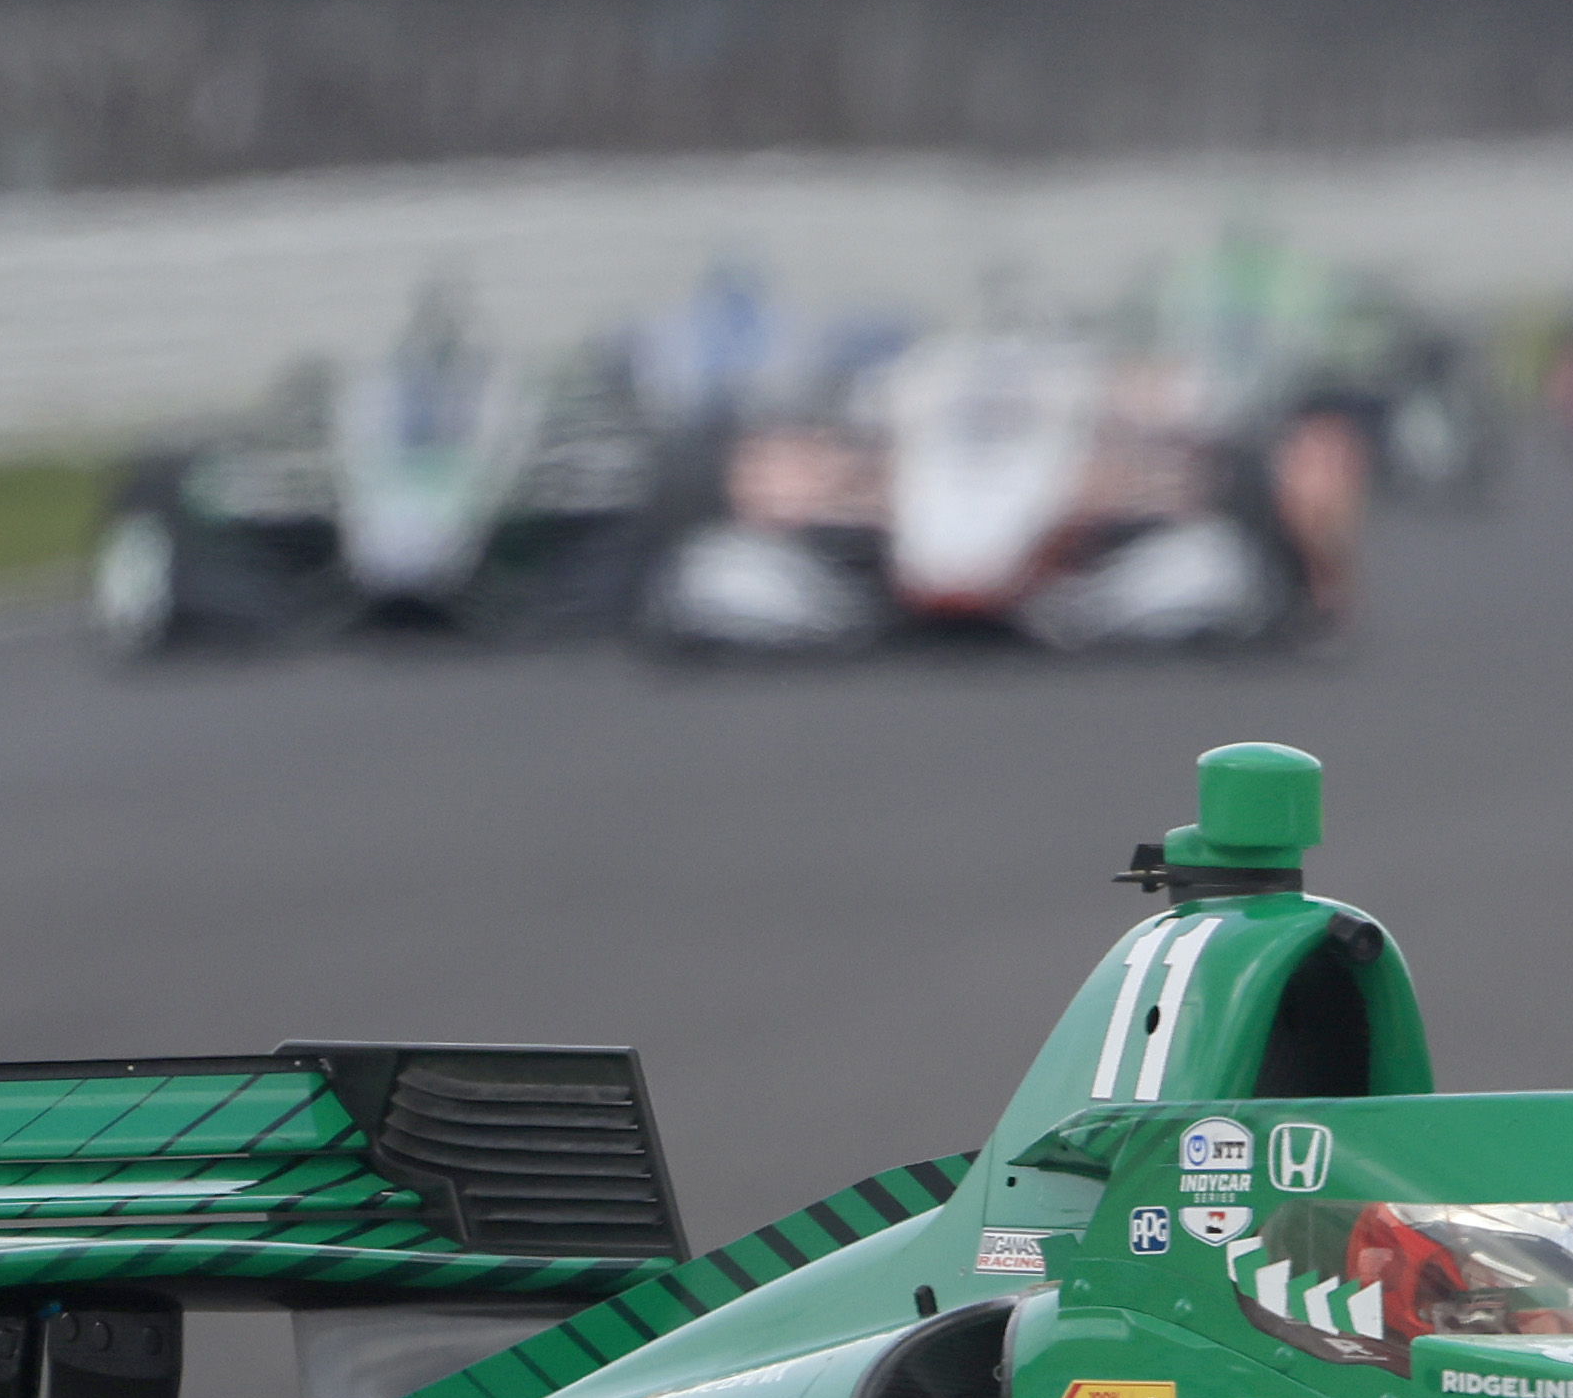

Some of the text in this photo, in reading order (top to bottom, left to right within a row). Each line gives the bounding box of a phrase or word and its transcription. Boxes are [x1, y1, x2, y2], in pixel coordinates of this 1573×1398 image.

[1088, 915, 1224, 1102] 11
[1180, 1174, 1252, 1192] INDYCAR
[1193, 1192, 1237, 1203] SERIES
[1133, 1211, 1168, 1250] PPG
[978, 1255, 1044, 1270] RACING
